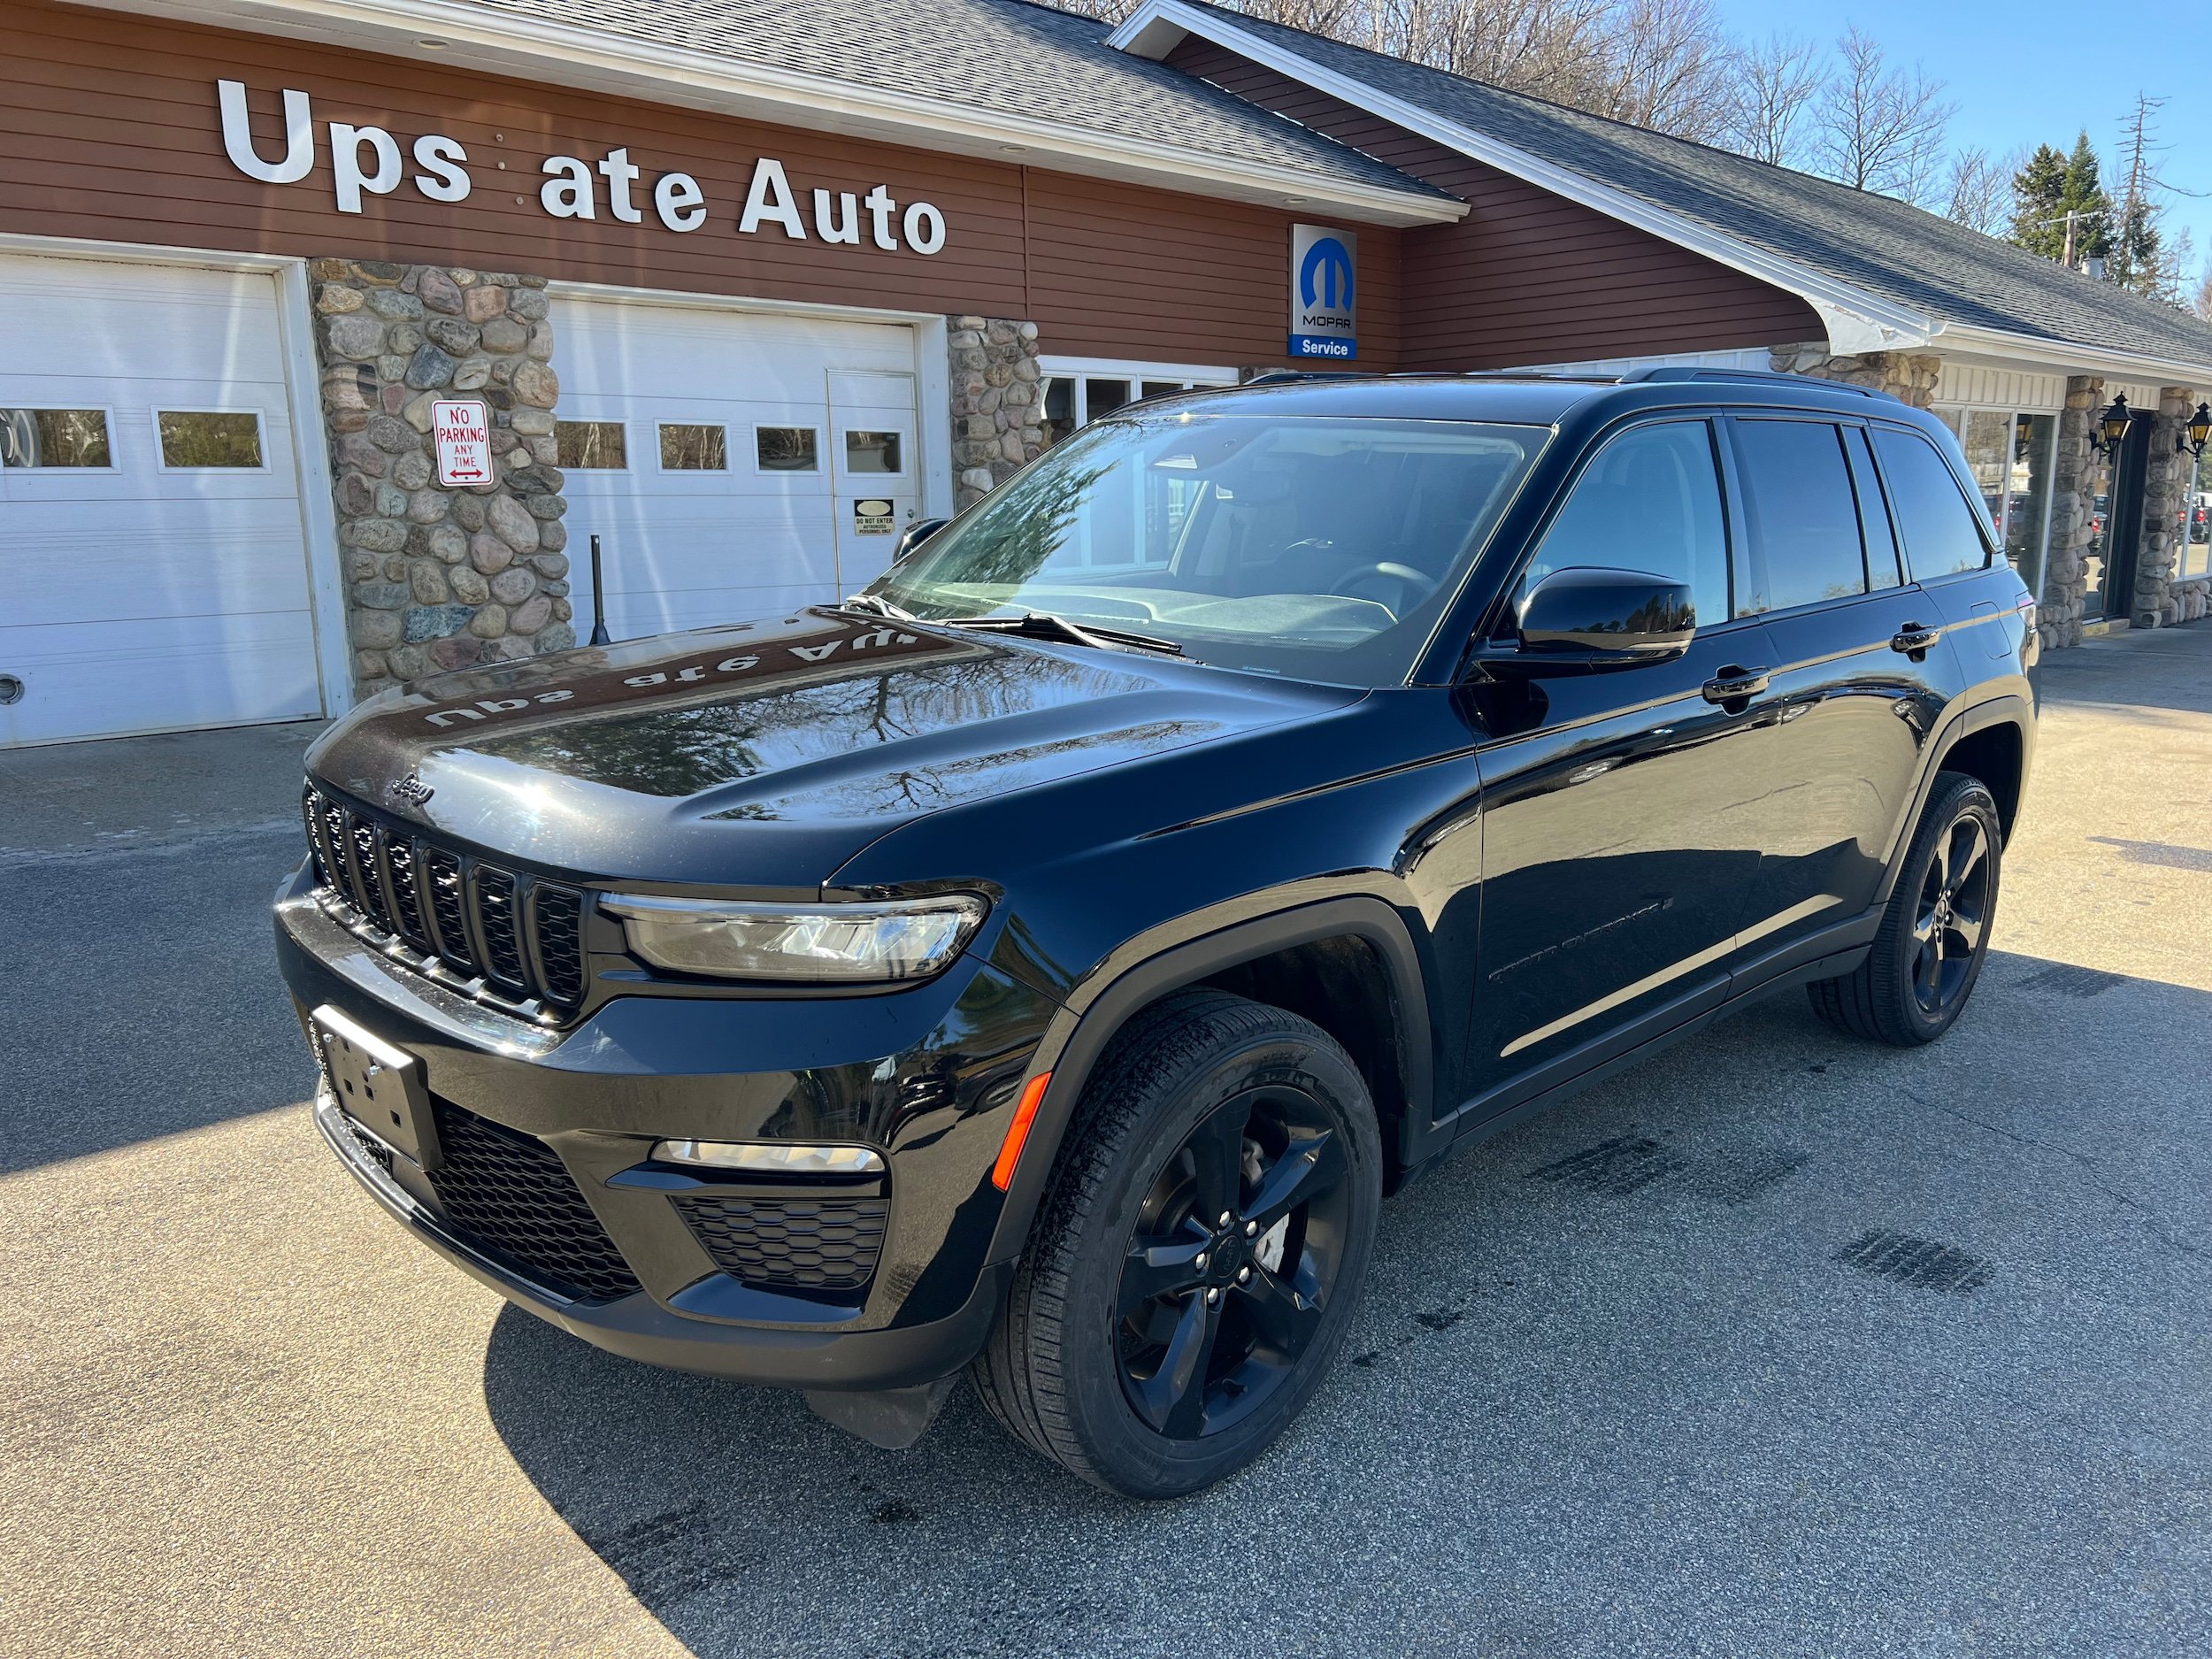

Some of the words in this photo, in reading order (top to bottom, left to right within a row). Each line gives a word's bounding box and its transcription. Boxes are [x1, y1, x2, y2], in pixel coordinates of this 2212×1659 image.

[217, 78, 472, 214] Ups
[540, 147, 708, 234] ate
[738, 157, 947, 256] Auto
[1302, 315, 1351, 329] MOPAR
[1302, 339, 1348, 356] Service
[449, 409, 470, 425] NO
[439, 427, 485, 442] PARKING
[454, 444, 473, 455] ANY
[453, 457, 477, 467] TIME
